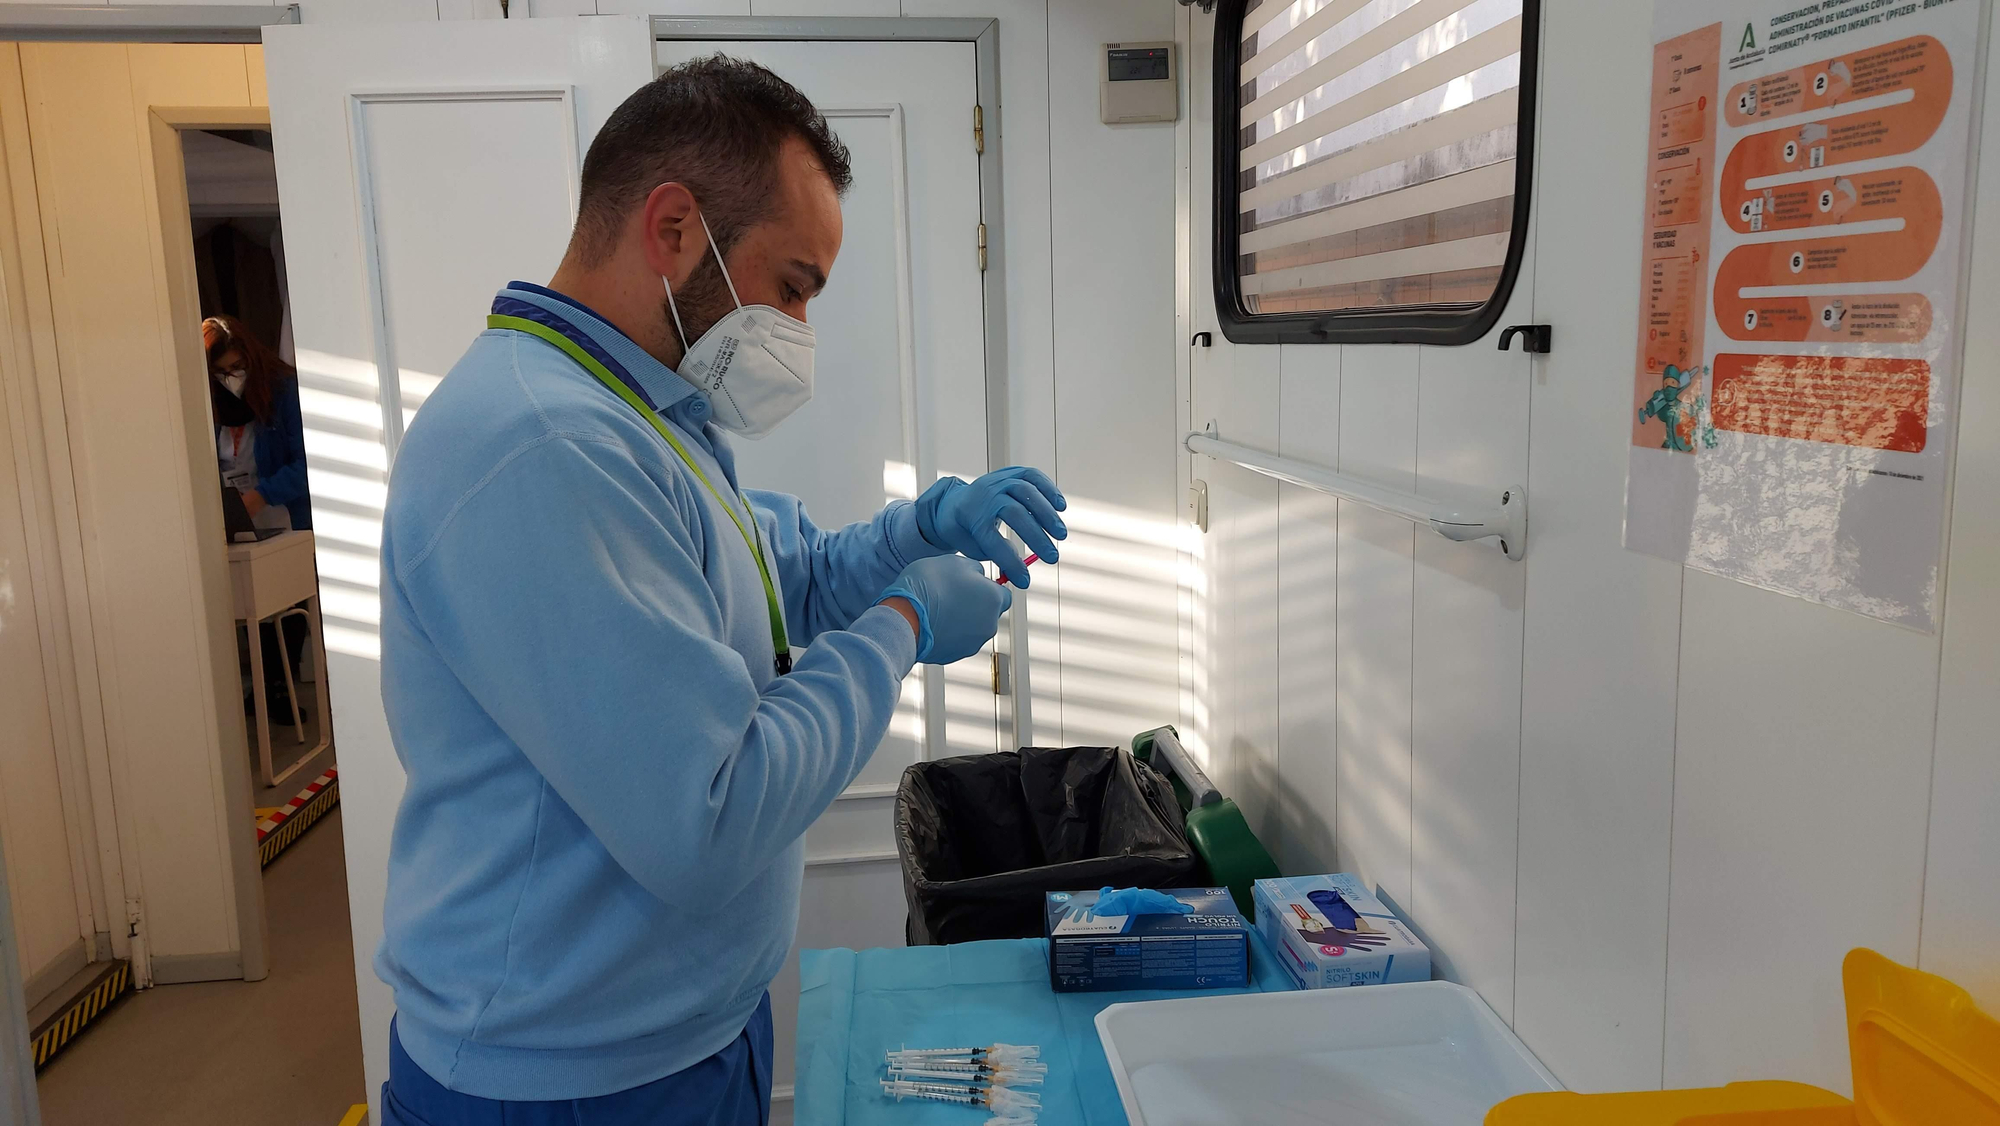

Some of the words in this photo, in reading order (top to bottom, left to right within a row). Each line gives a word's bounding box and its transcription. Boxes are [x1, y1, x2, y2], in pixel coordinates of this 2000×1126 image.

[1885, 3, 1917, 21] (PFIZER
[1769, 15, 1825, 41] ADMINISTRACIÓN
[1825, 14, 1835, 24] DE
[1835, 4, 1870, 21] VACUNAS
[1816, 77, 1824, 89] 2
[1740, 97, 1746, 108] 1
[1786, 145, 1794, 156] 3
[1822, 195, 1829, 206] 5
[1743, 205, 1750, 216] 4
[1793, 256, 1800, 267] 6
[1747, 314, 1754, 325] 7
[1824, 309, 1830, 321] 8
[1326, 967, 1351, 975] NITRILO
[1326, 970, 1380, 984] SOFTSKIN
